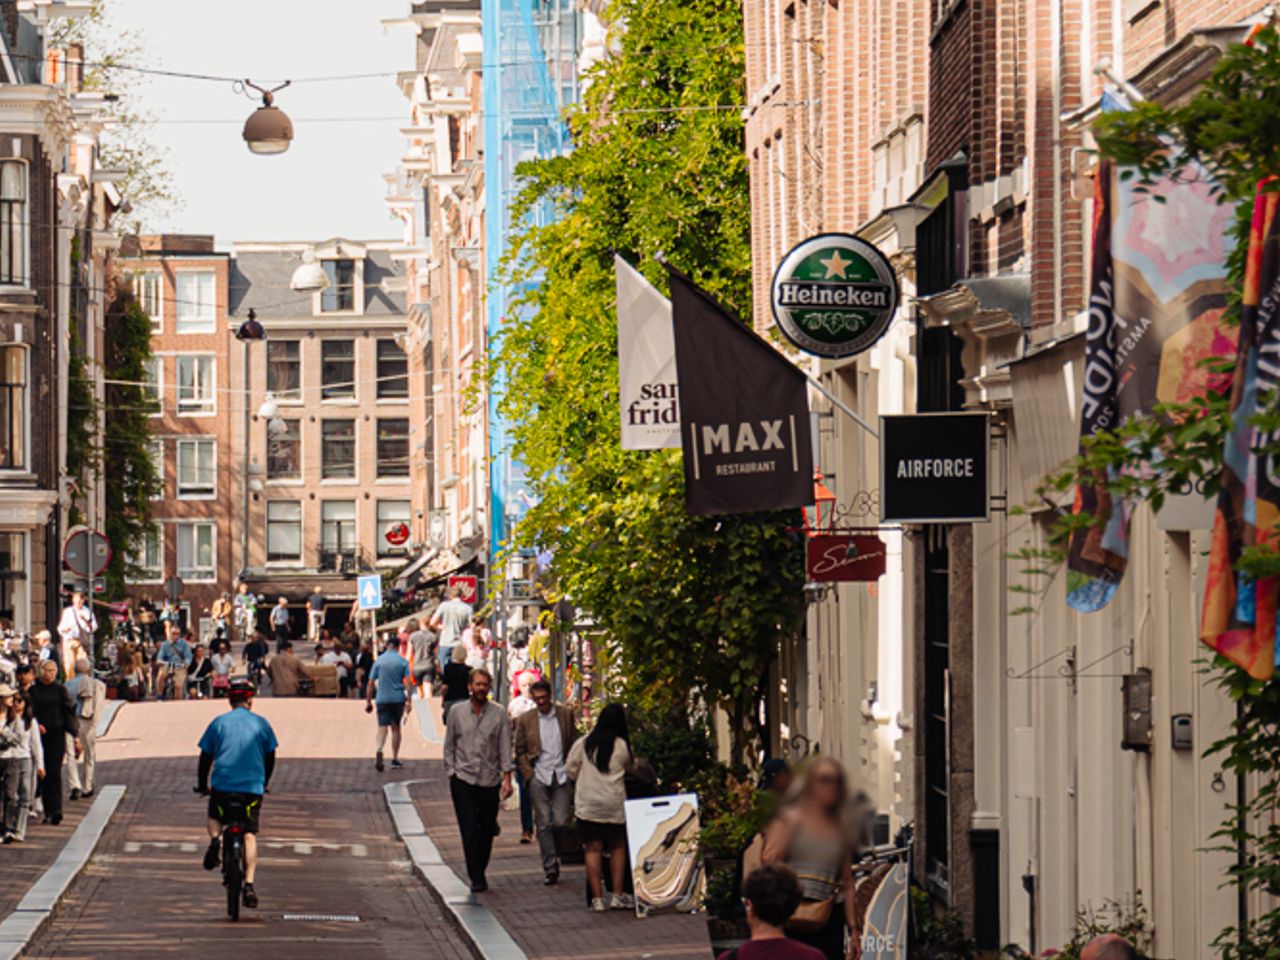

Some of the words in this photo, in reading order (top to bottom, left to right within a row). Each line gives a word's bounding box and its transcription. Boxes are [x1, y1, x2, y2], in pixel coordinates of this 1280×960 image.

[781, 284, 887, 306] Heineken
[702, 419, 785, 456] MAX
[716, 460, 775, 476] RESTAURANT
[897, 458, 974, 478] AIRFORCE
